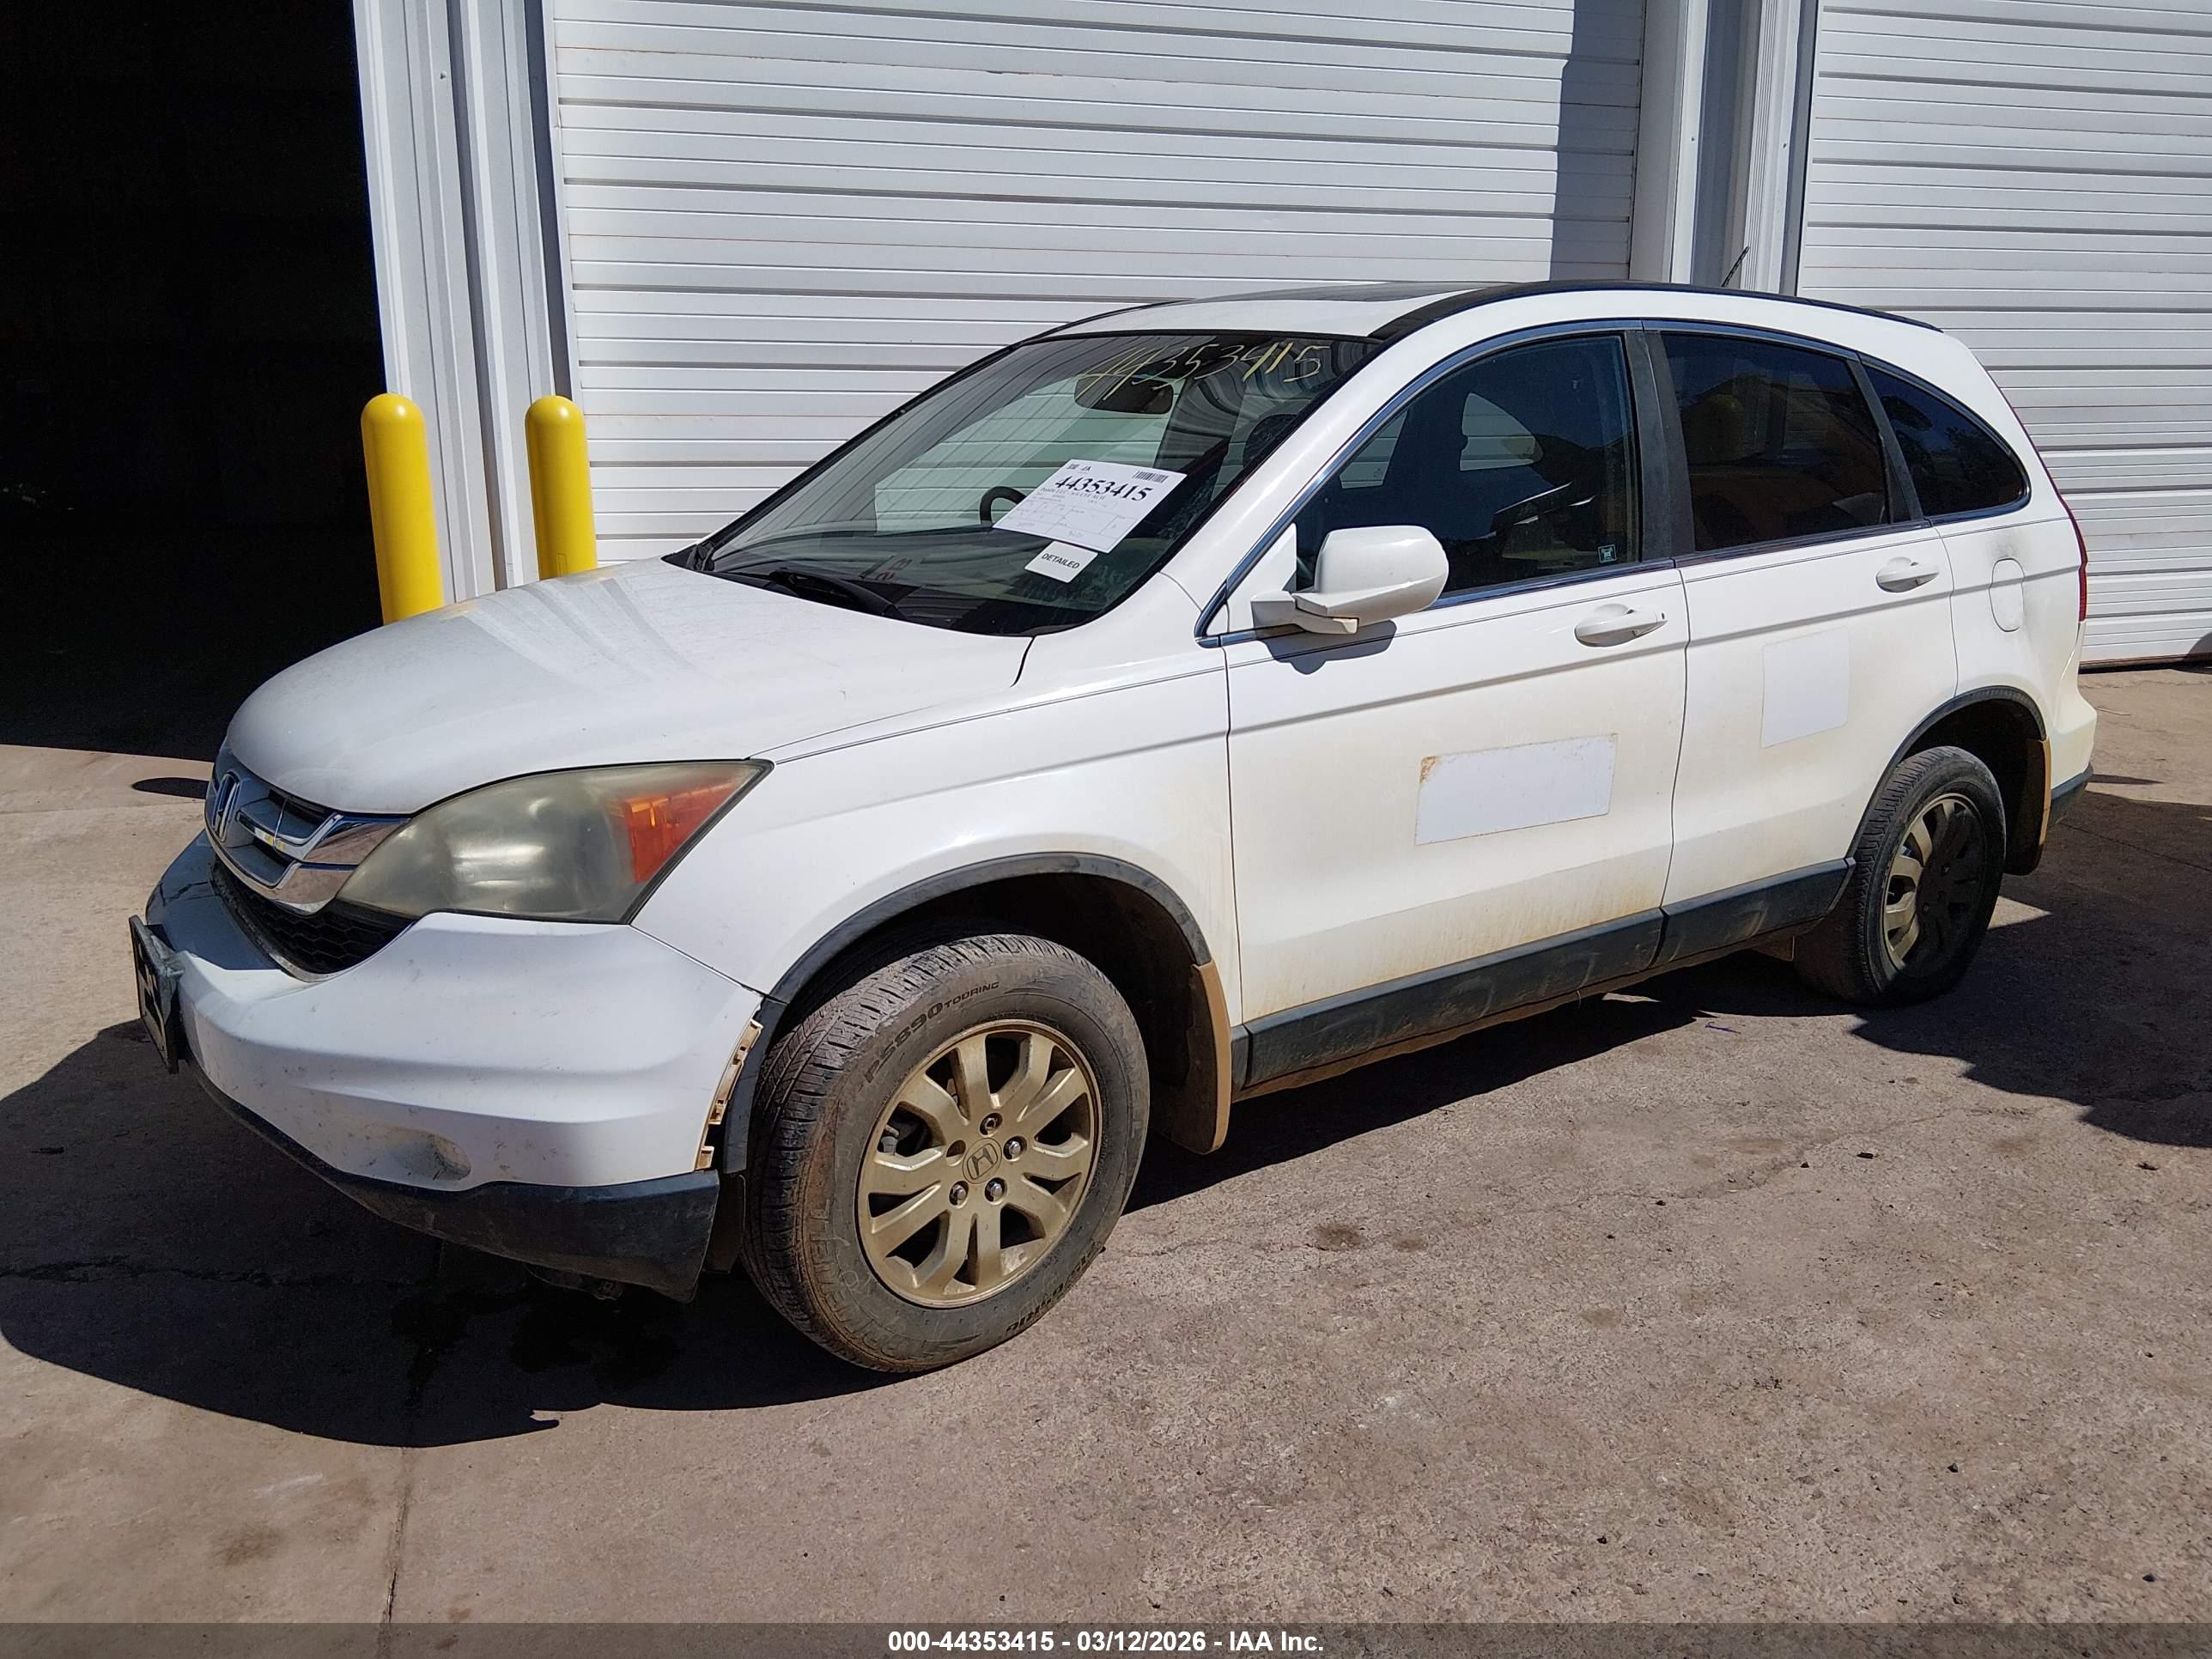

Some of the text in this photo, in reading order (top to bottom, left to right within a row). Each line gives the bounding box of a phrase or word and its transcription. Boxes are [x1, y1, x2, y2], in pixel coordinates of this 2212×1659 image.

[1075, 341, 1330, 401] 44353415
[1054, 475, 1153, 501] 44353415
[1041, 551, 1081, 570] DETAILED
[863, 981, 1000, 1084] PS890 TOURING
